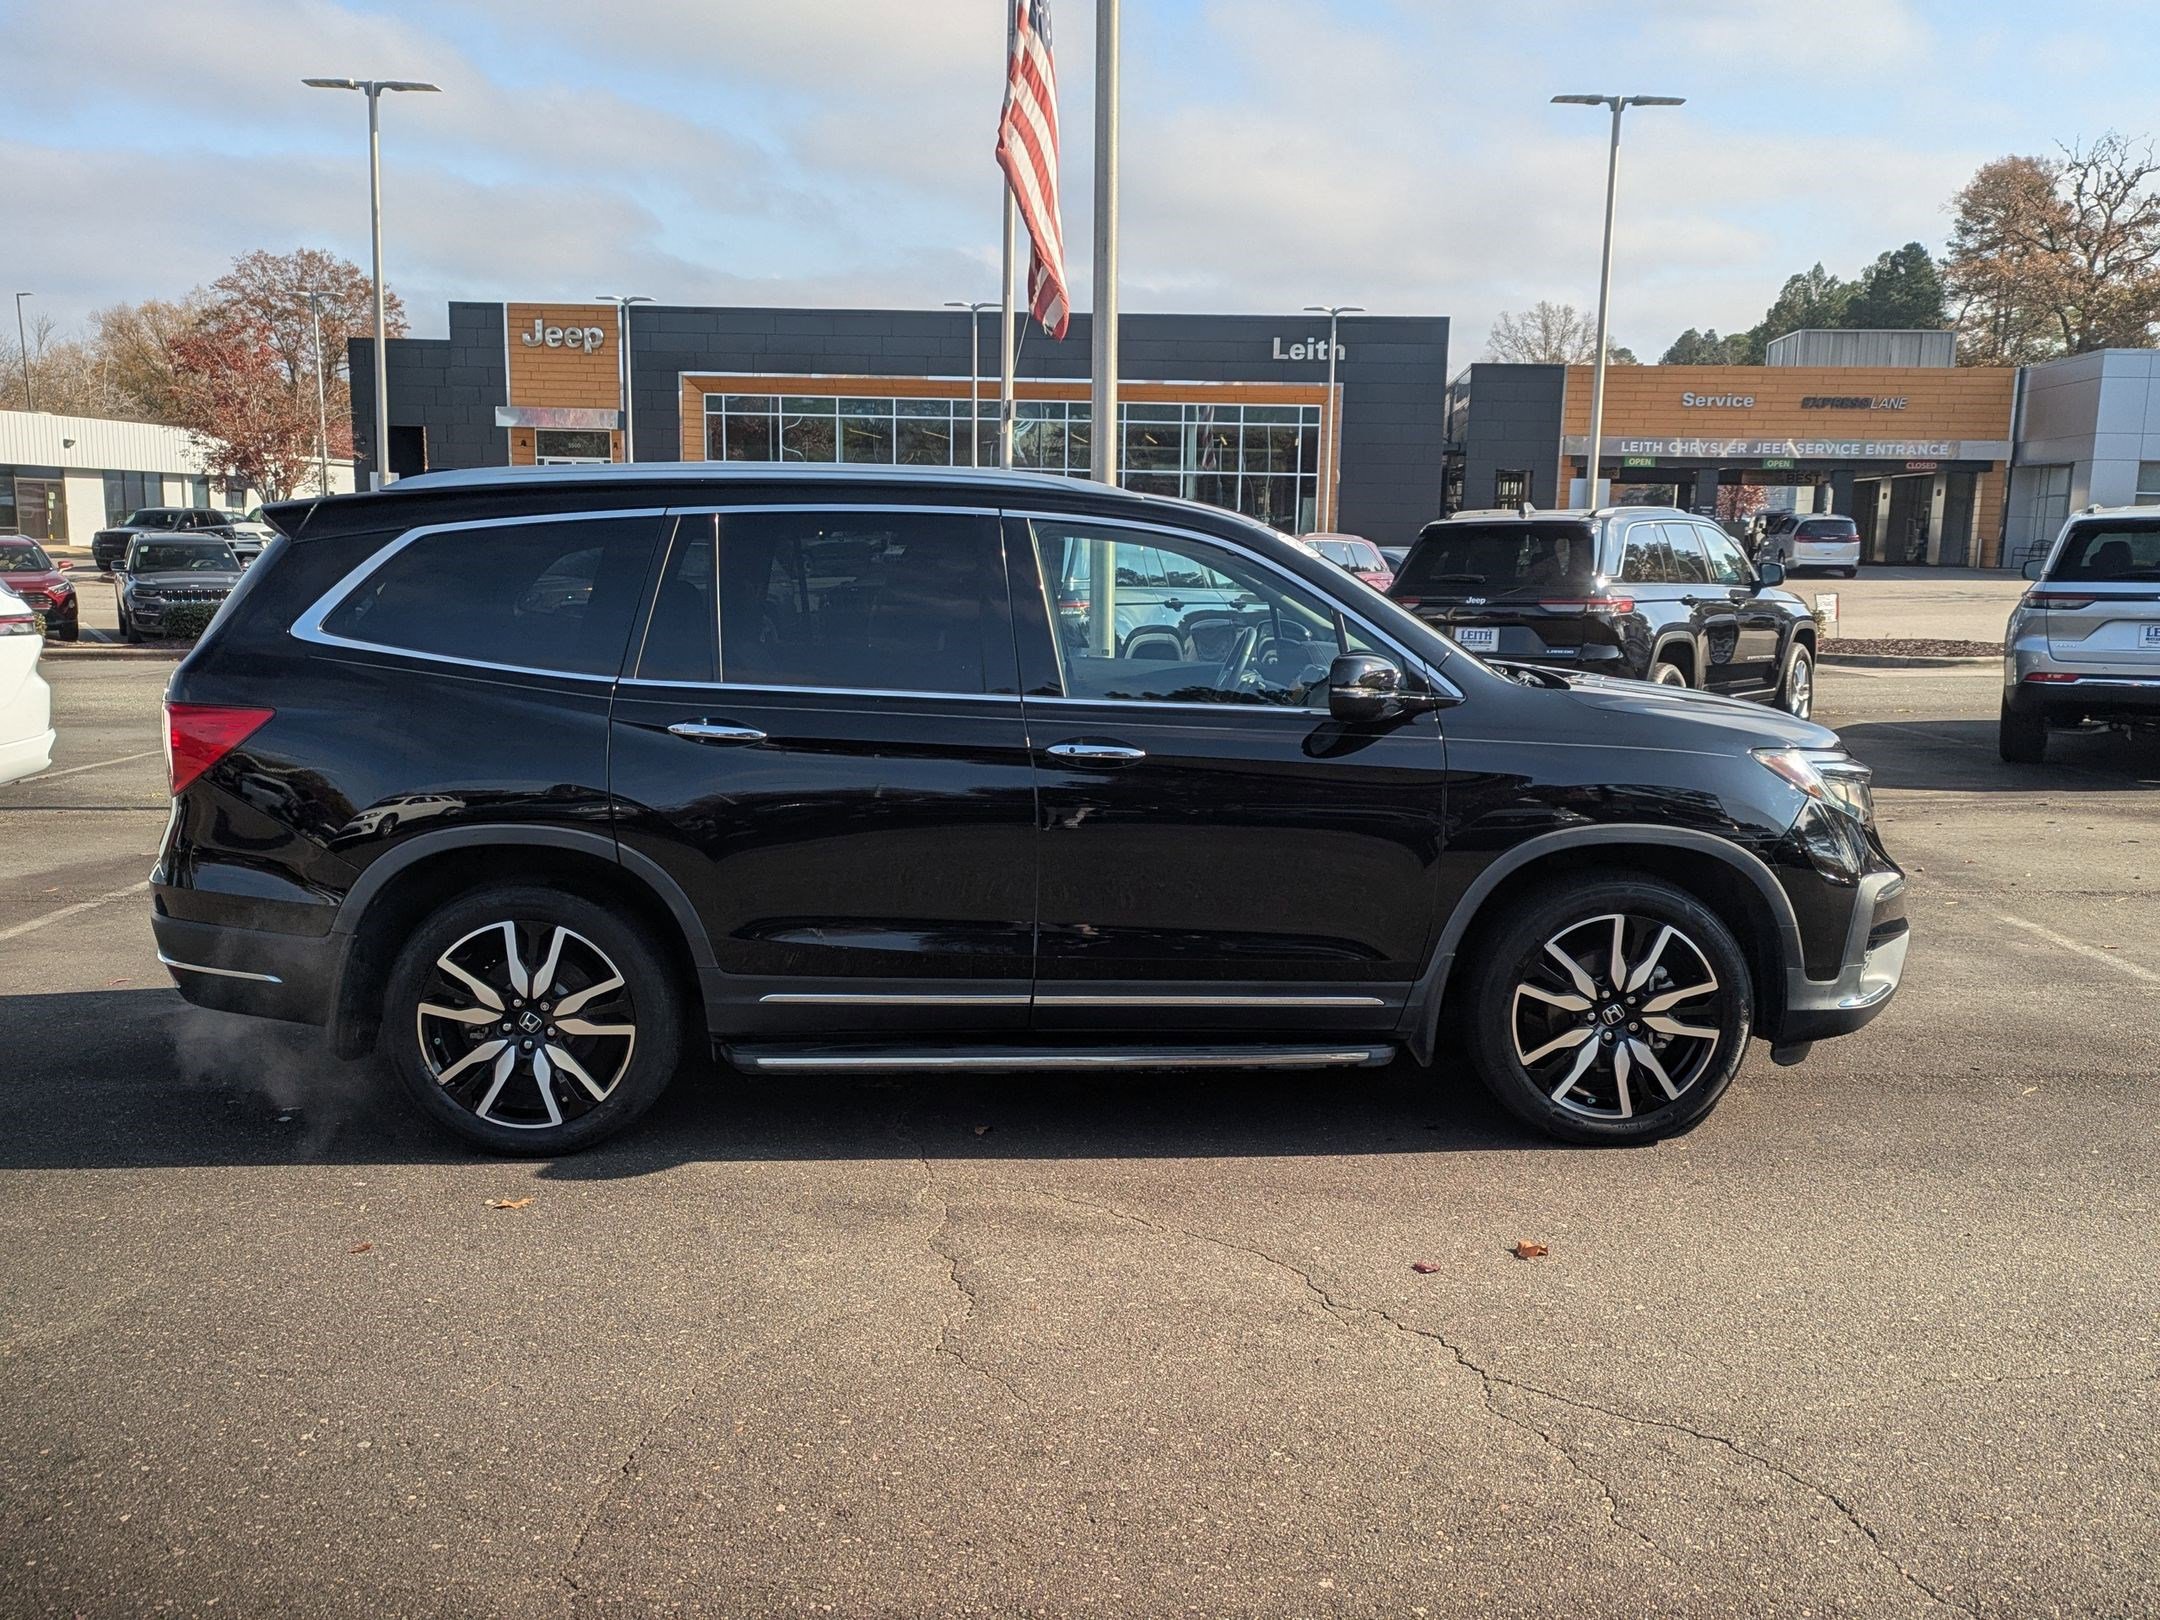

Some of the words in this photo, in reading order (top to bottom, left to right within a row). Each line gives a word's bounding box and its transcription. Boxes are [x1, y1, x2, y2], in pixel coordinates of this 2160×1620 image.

[521, 318, 604, 353] Jeep
[1273, 337, 1345, 360] Leith
[1682, 392, 1755, 408] Service
[1621, 441, 1663, 453] LEITH
[1668, 442, 1747, 454] CHRYSLER
[1797, 443, 1860, 455] SERVICE
[1865, 443, 1947, 456] ENTRANCE
[1629, 458, 1652, 466] OPEN
[1906, 462, 1937, 470] CLOSED
[1466, 596, 1486, 605] Jeep
[1461, 630, 1492, 640] LEITH
